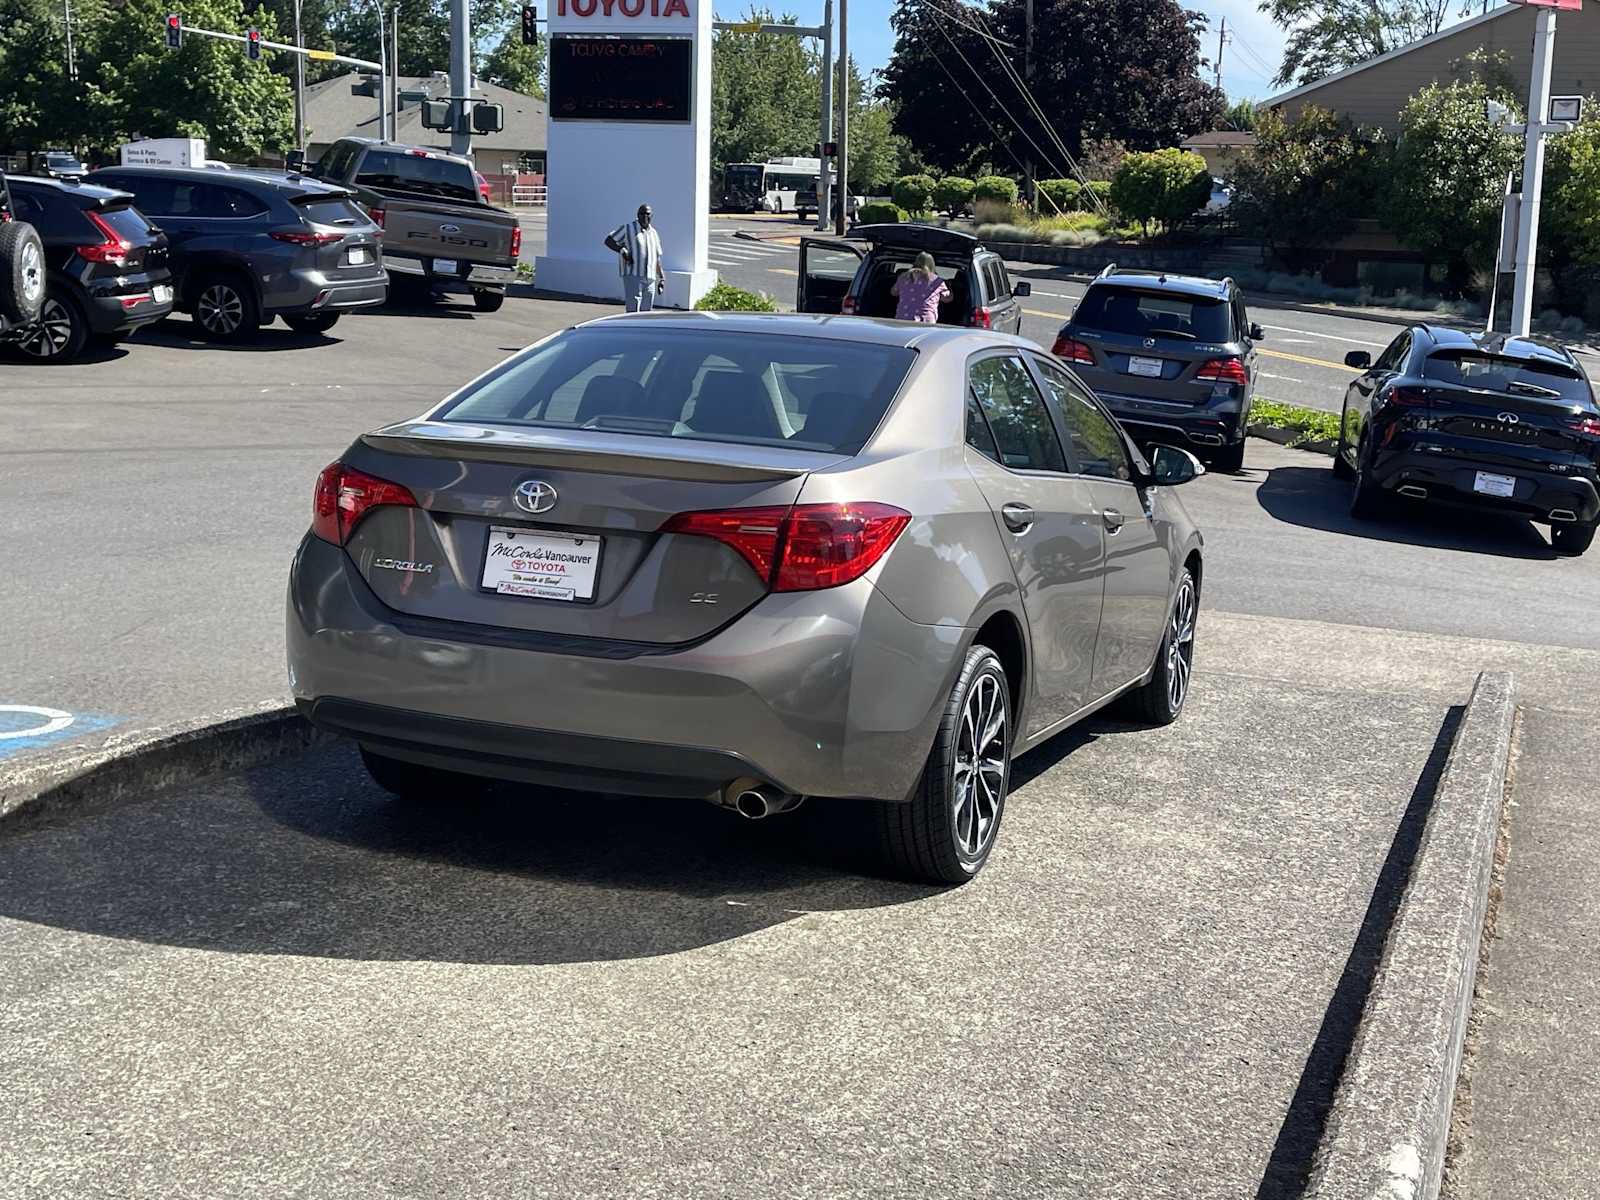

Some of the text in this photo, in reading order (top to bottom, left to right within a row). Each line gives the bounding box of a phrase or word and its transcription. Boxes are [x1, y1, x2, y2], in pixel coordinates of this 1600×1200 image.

[557, 0, 691, 17] TOYOTA
[408, 231, 488, 248] F-150
[374, 558, 434, 573] COROLLA
[527, 561, 566, 573] TOYOTA
[689, 592, 719, 603] SE
